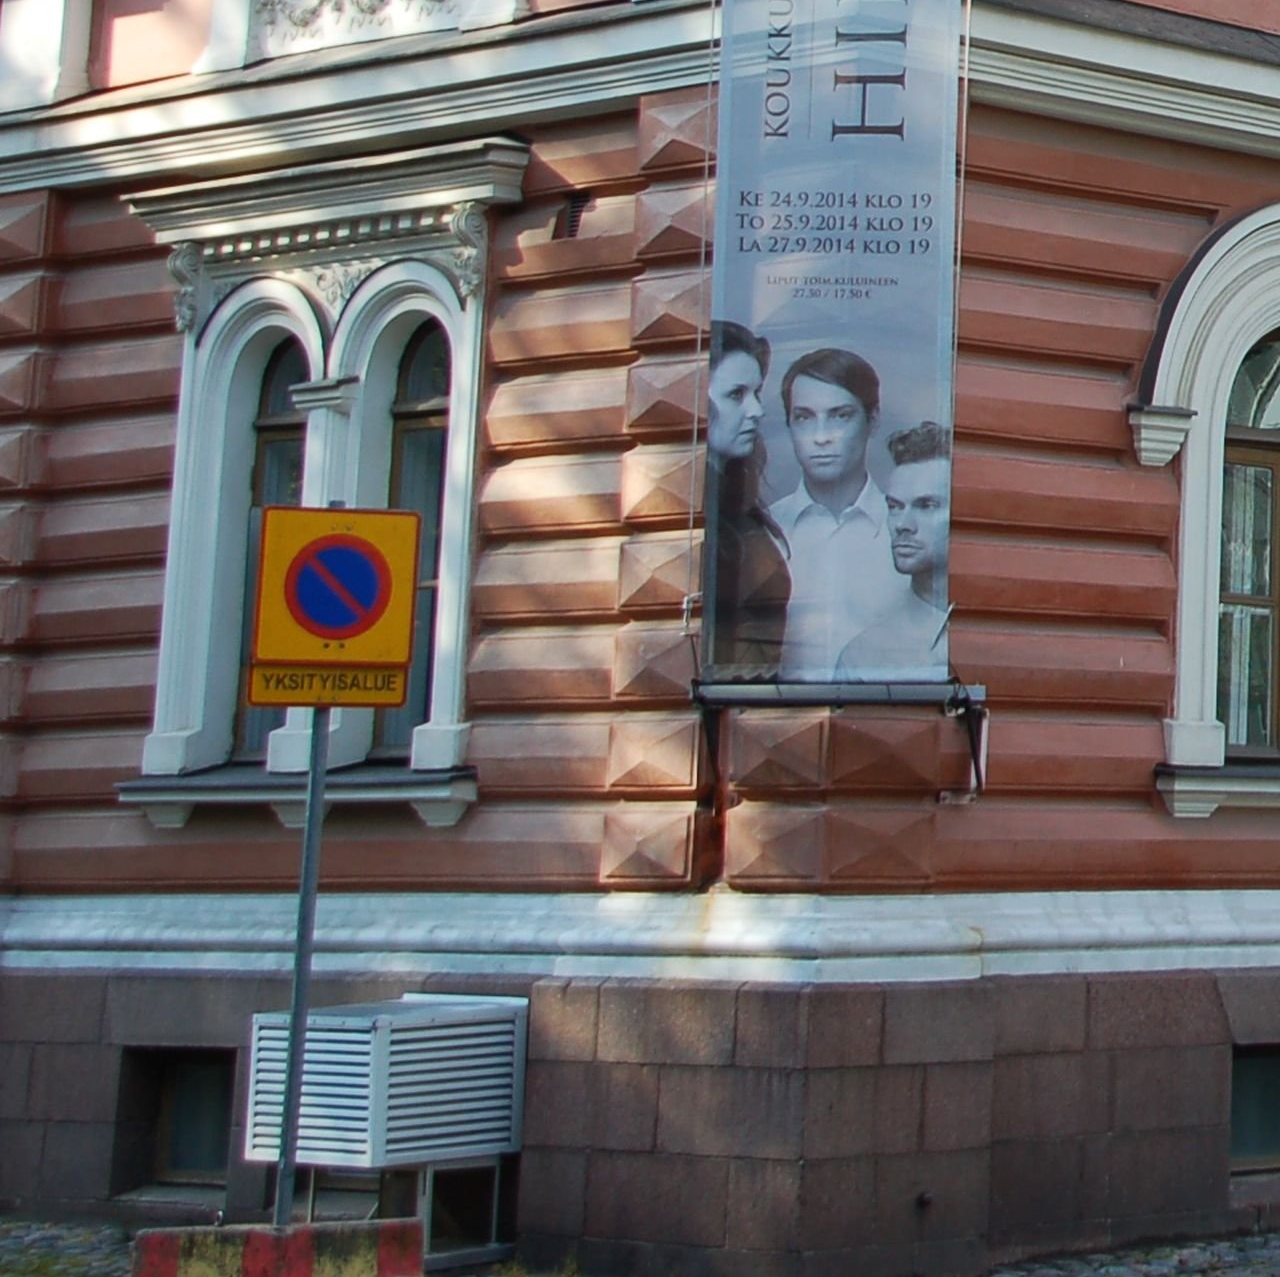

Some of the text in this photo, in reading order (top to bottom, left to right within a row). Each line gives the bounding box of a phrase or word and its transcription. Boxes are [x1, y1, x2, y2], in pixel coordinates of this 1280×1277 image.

[770, 191, 858, 209] 24.9.2014
[865, 194, 903, 209] KLO
[911, 193, 932, 209] 19
[771, 214, 858, 231] 25.9.2014
[866, 217, 904, 232] KLO
[913, 215, 933, 232] 19
[768, 236, 856, 254] 27.9.2014
[863, 239, 900, 254] KLO
[909, 238, 930, 254] 19
[262, 673, 398, 691] YKSITYISALUE
